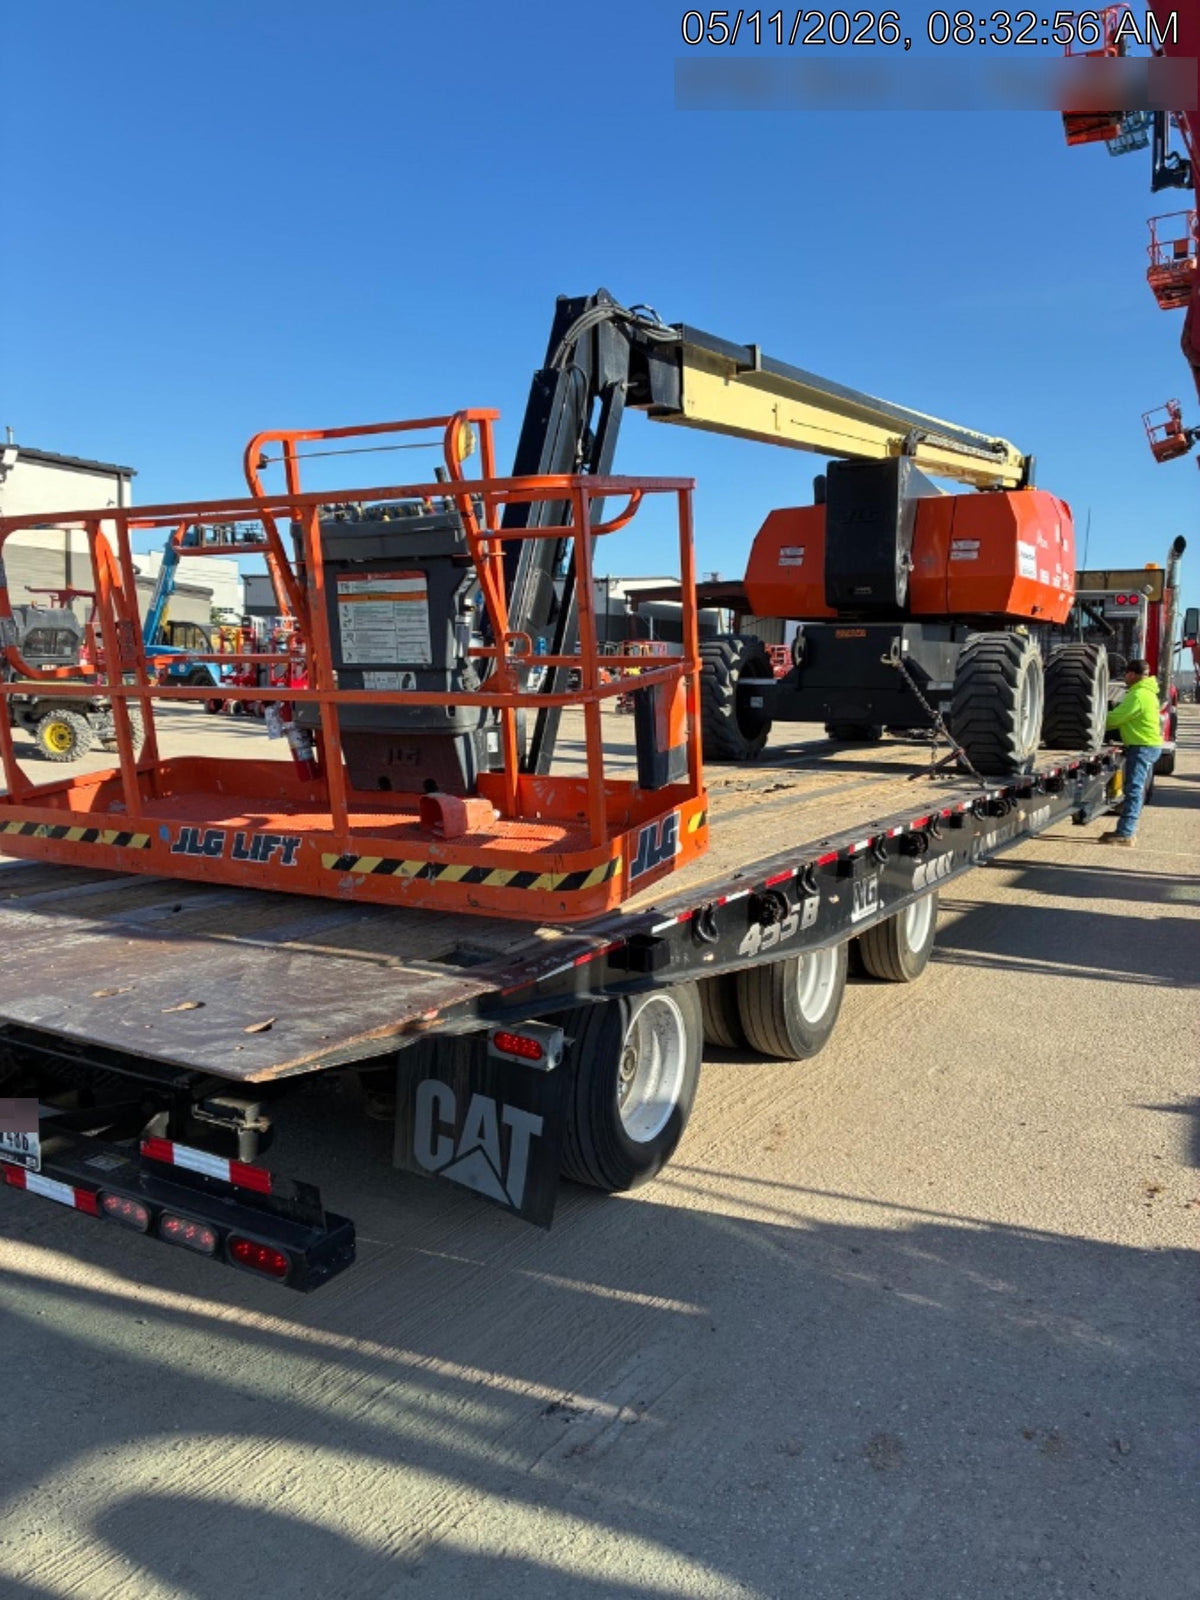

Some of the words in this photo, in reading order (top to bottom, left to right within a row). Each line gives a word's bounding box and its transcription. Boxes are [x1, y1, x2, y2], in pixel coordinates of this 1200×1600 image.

[170, 826, 227, 858] JLG
[231, 831, 302, 866] LIFT
[628, 809, 681, 881] JLG
[413, 1078, 544, 1210] CAT
